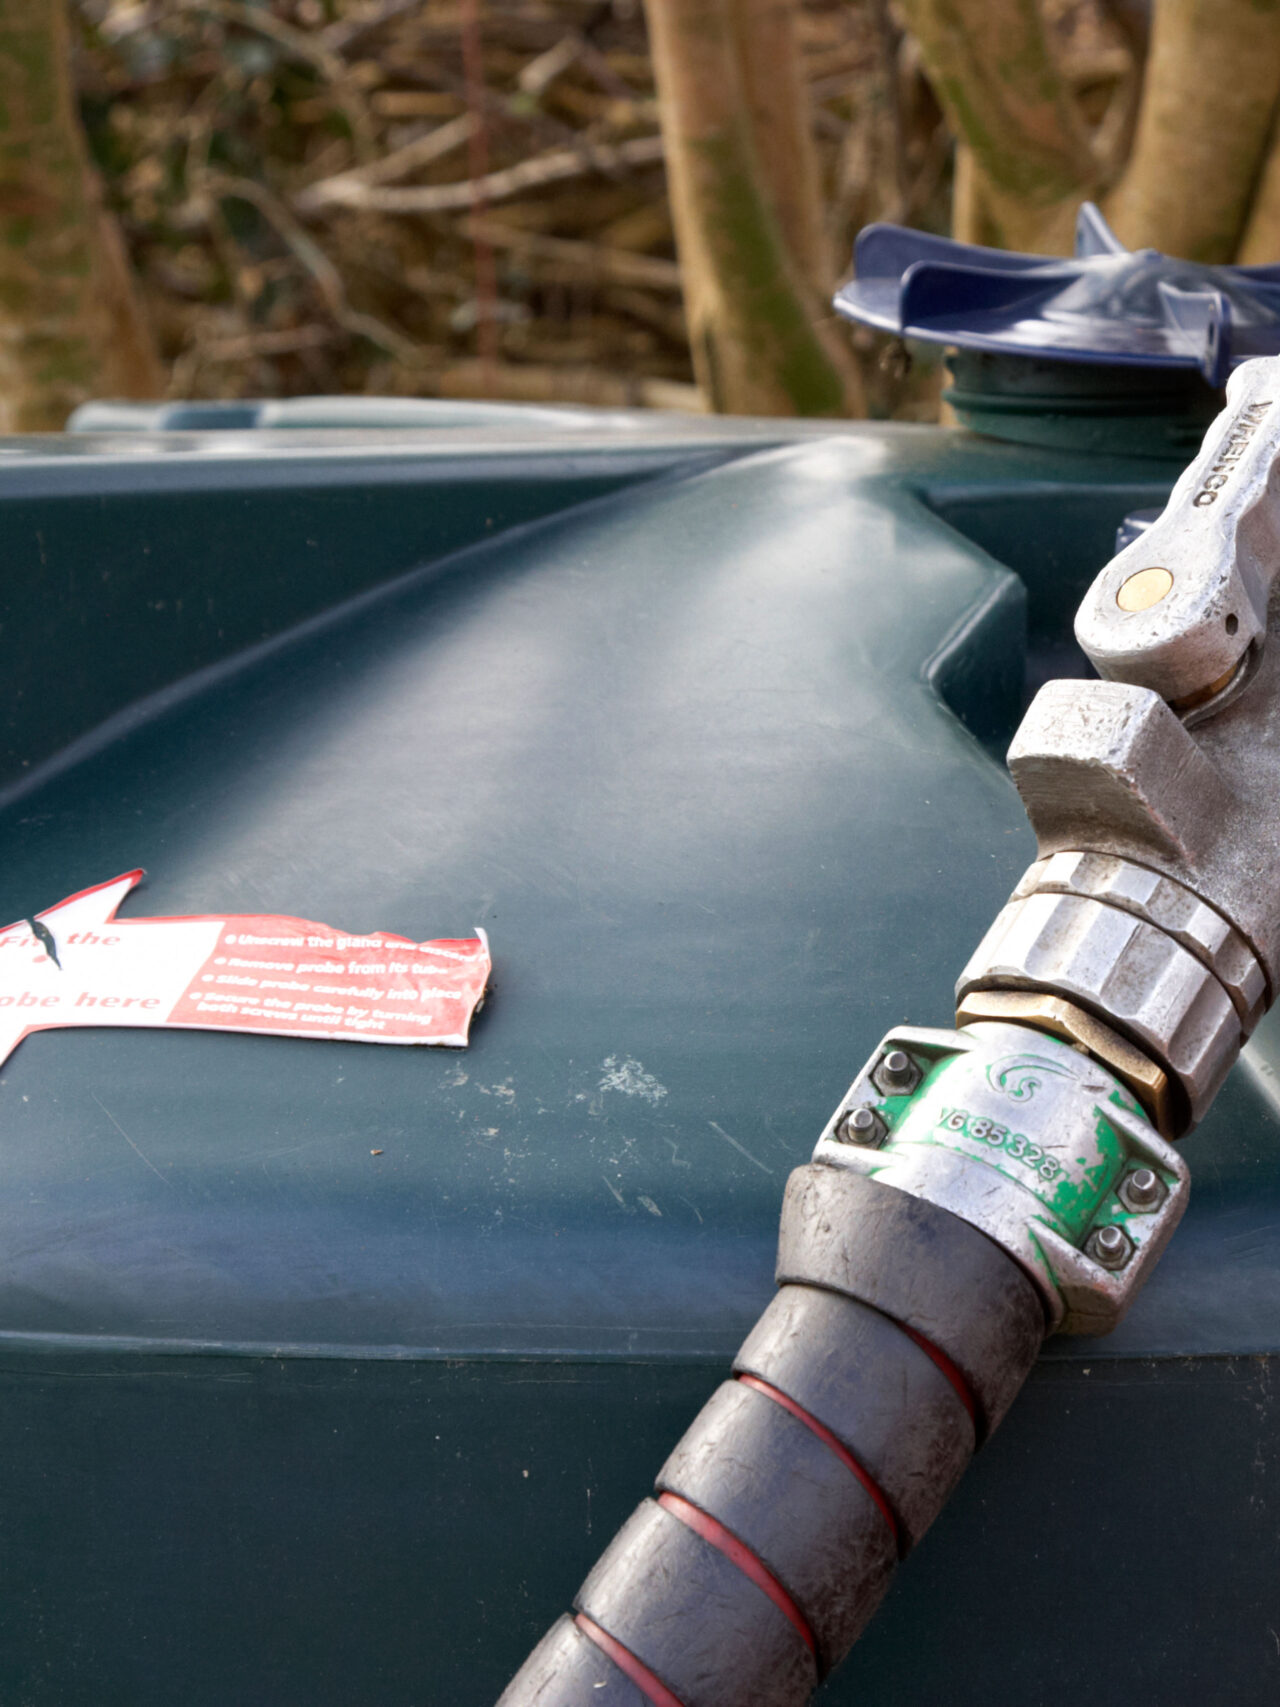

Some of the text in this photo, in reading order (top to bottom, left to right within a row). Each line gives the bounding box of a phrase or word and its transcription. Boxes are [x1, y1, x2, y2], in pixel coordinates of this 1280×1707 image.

[66, 931, 121, 946] the
[238, 934, 304, 947] Unscrew
[307, 936, 334, 947] the
[227, 957, 295, 971] Remove
[295, 961, 345, 974] probe
[348, 961, 386, 974] from
[215, 974, 462, 1002] Slide probe carefully into place
[73, 991, 161, 1009] here
[203, 992, 432, 1025] Secure the probe by turning
[196, 1001, 386, 1030] both screws until tight
[972, 1116, 1005, 1147] 85
[1008, 1134, 1062, 1181] 328
